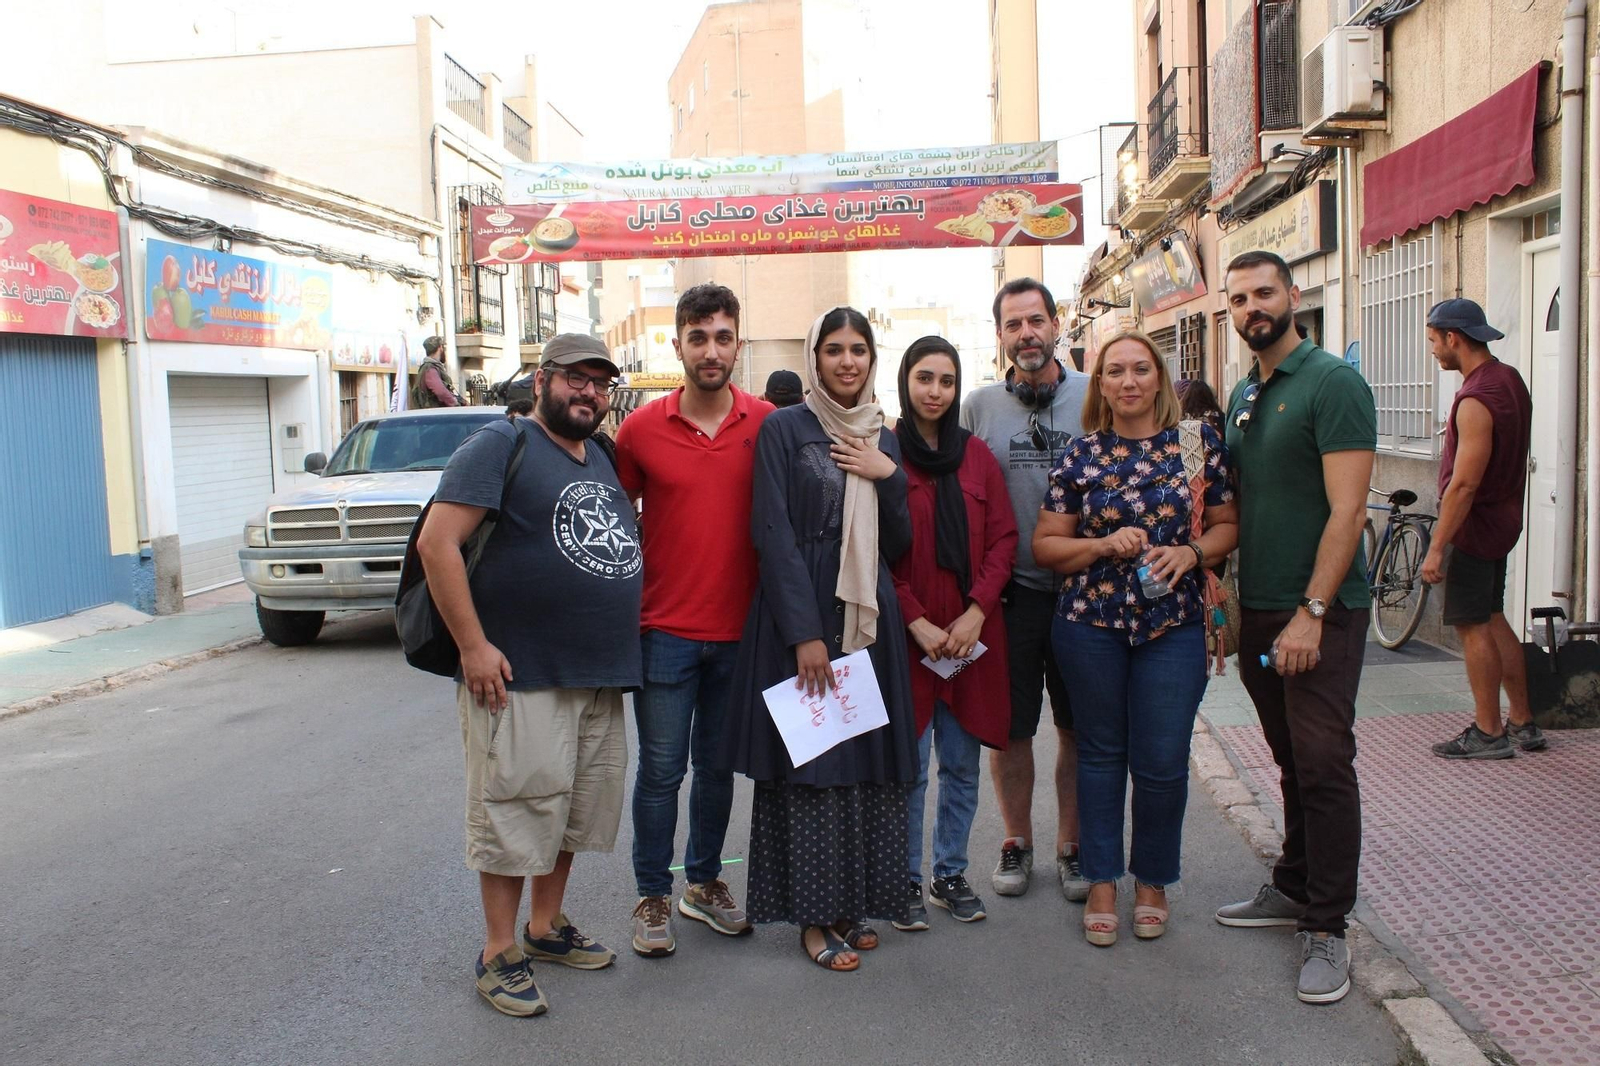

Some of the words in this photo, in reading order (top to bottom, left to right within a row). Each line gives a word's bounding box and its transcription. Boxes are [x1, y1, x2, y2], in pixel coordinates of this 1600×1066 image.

[827, 153, 884, 166] افغانستان
[889, 151, 914, 164] های
[984, 146, 1014, 160] خالص
[605, 161, 647, 179] شده
[651, 162, 692, 181] بوتل
[836, 164, 860, 178] شما
[908, 163, 929, 178] رفع
[932, 161, 956, 176] برای
[961, 161, 977, 174] راه
[527, 178, 560, 195] خالص
[562, 180, 590, 195] منبع
[623, 186, 667, 199] NATURAL
[671, 185, 714, 198] MINERAL
[718, 183, 752, 196] WATER
[873, 181, 895, 190] MORE
[896, 179, 948, 189] INFORMATION
[627, 201, 683, 231] کابل
[689, 200, 757, 229] محلی
[763, 196, 828, 226] غذای
[834, 194, 925, 222] بهترین
[652, 231, 684, 248] کنید
[688, 229, 736, 247] امتحان
[740, 229, 772, 245] ماره
[777, 225, 840, 244] خوشمزه
[844, 223, 901, 242] غذاهای
[0, 255, 35, 277] رستو
[186, 255, 218, 296] کابل
[0, 278, 20, 299] غذ
[23, 284, 72, 307] بهترین
[210, 305, 234, 321] KABUL
[233, 307, 252, 322] CASH
